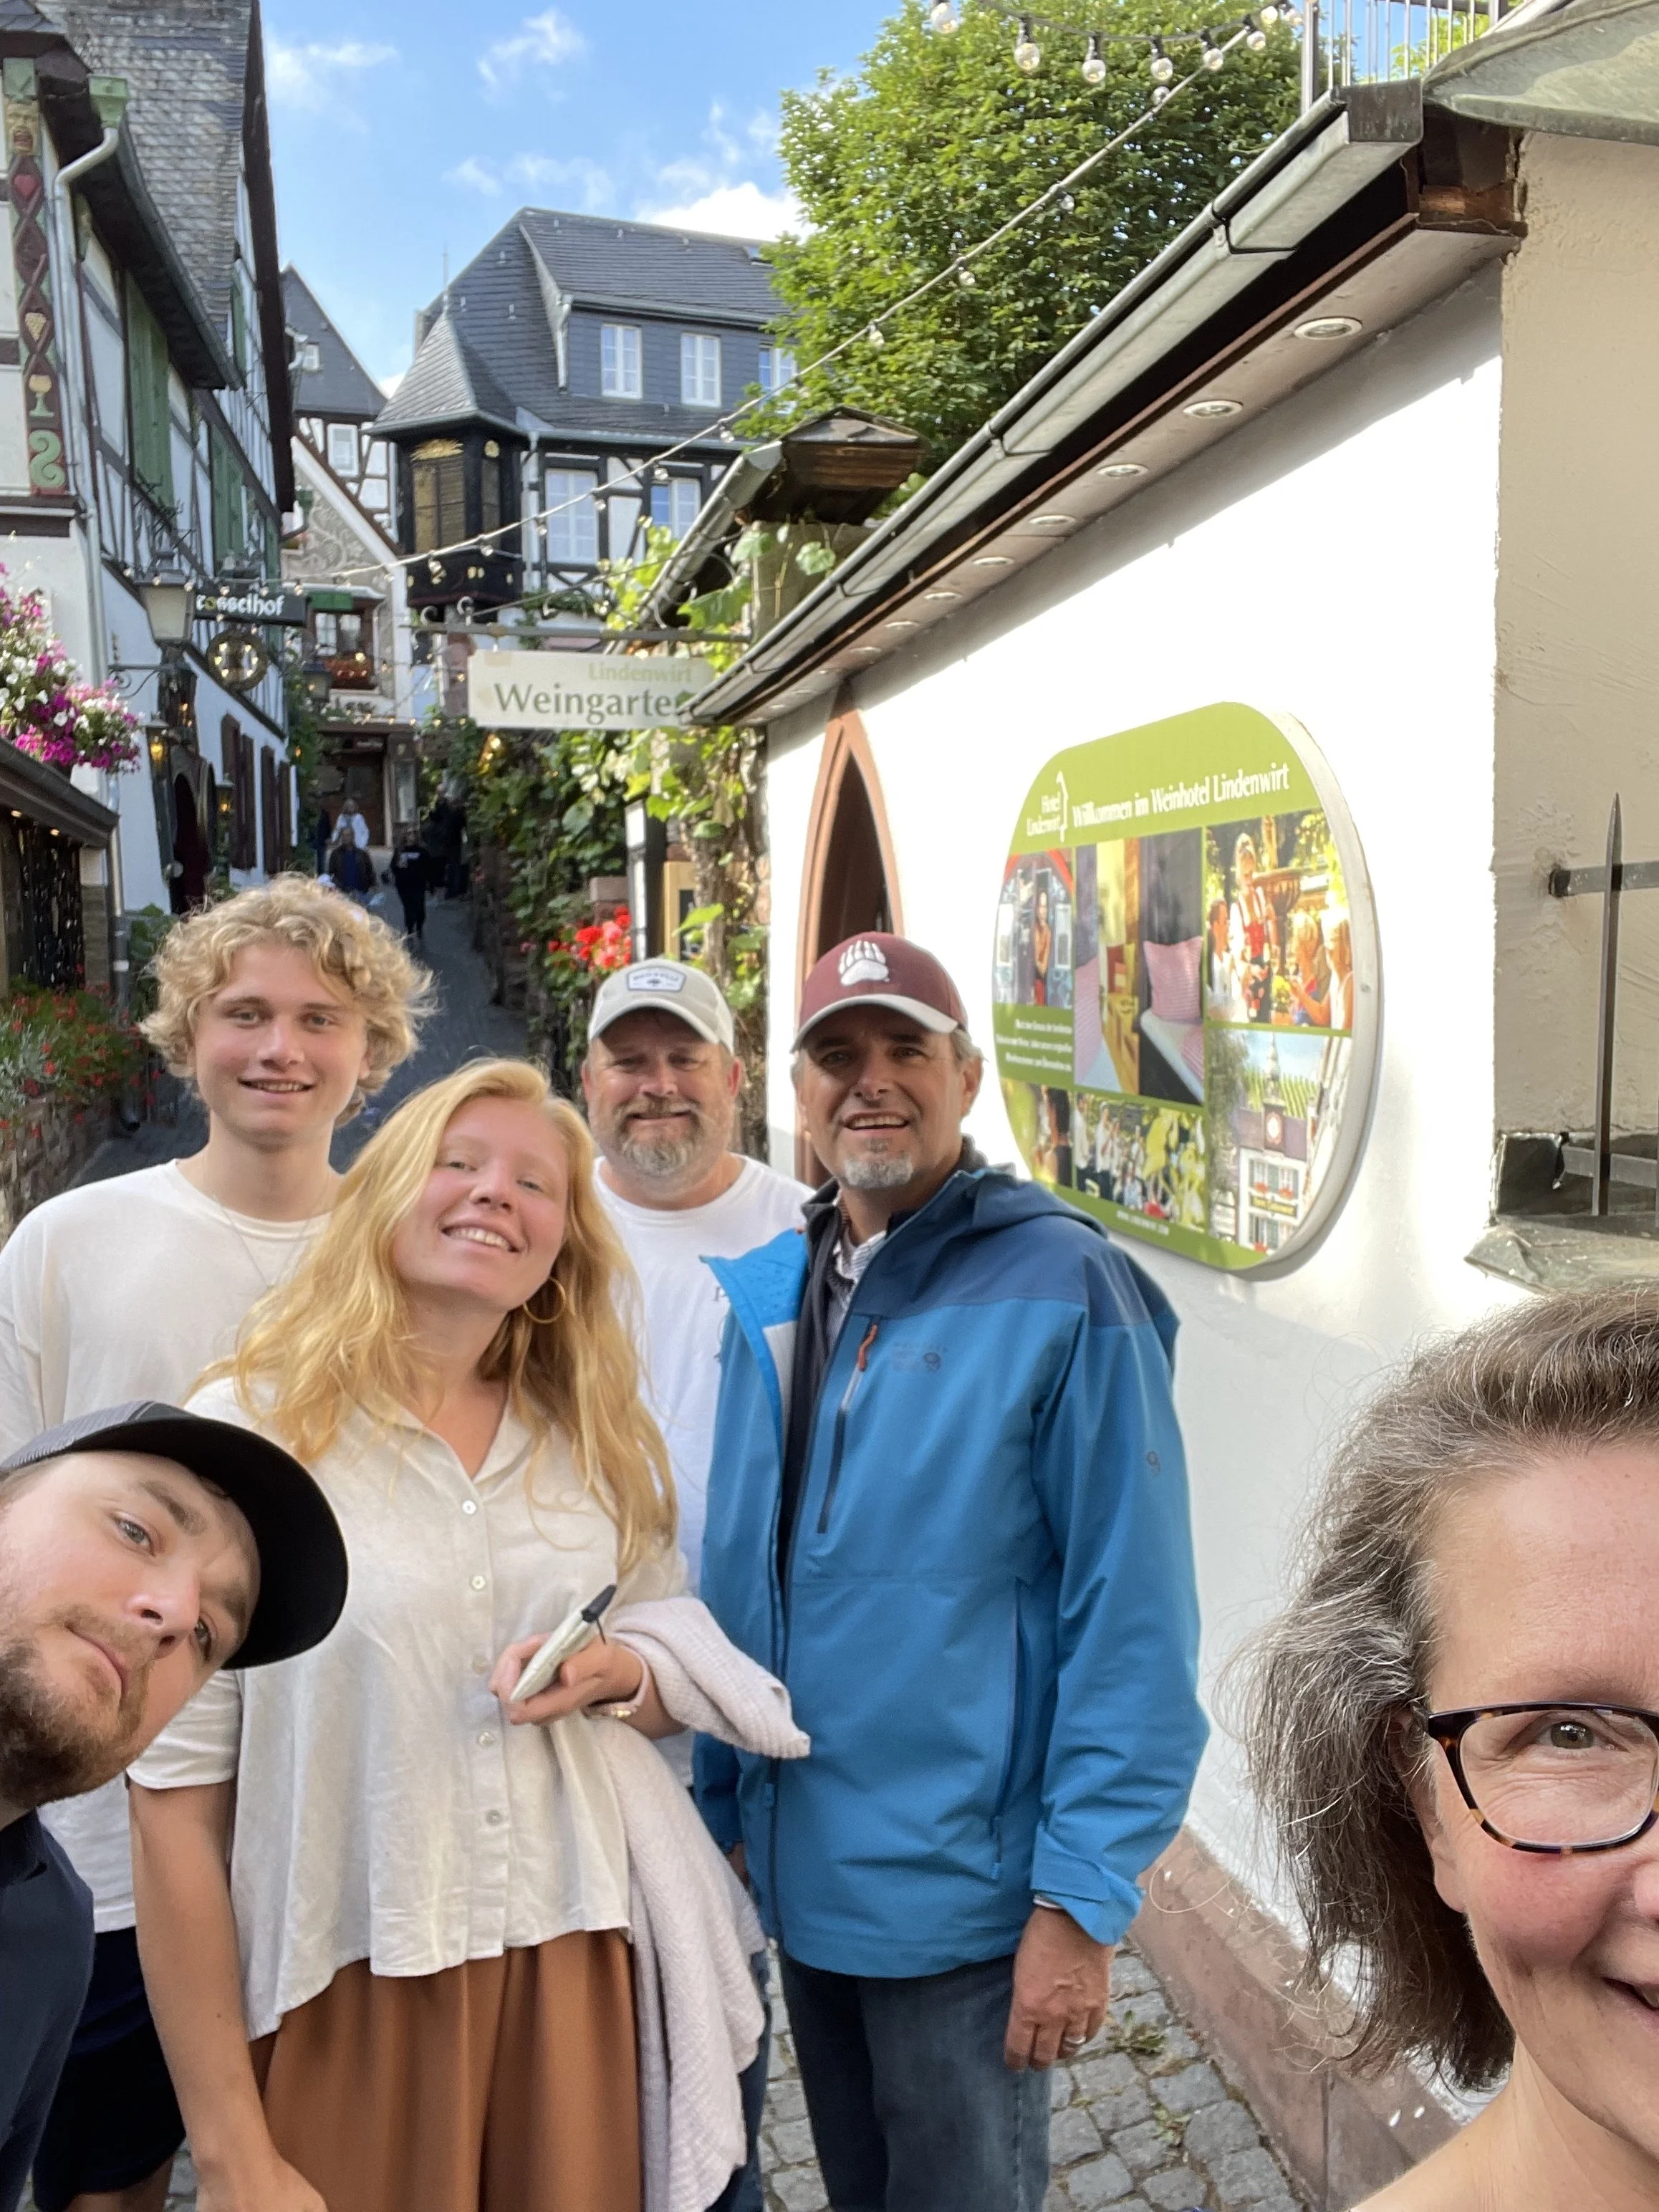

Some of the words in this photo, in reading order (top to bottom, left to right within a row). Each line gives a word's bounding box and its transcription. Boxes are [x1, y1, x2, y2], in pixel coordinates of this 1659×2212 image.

[196, 593, 286, 616] rosselhof
[588, 661, 693, 683] Lindenwirt
[493, 682, 679, 725] Weingarte
[1072, 801, 1132, 828] Willkommen
[1134, 792, 1149, 817] im
[1150, 776, 1210, 814] Weinhotel
[1213, 762, 1289, 802] Lindenwirt
